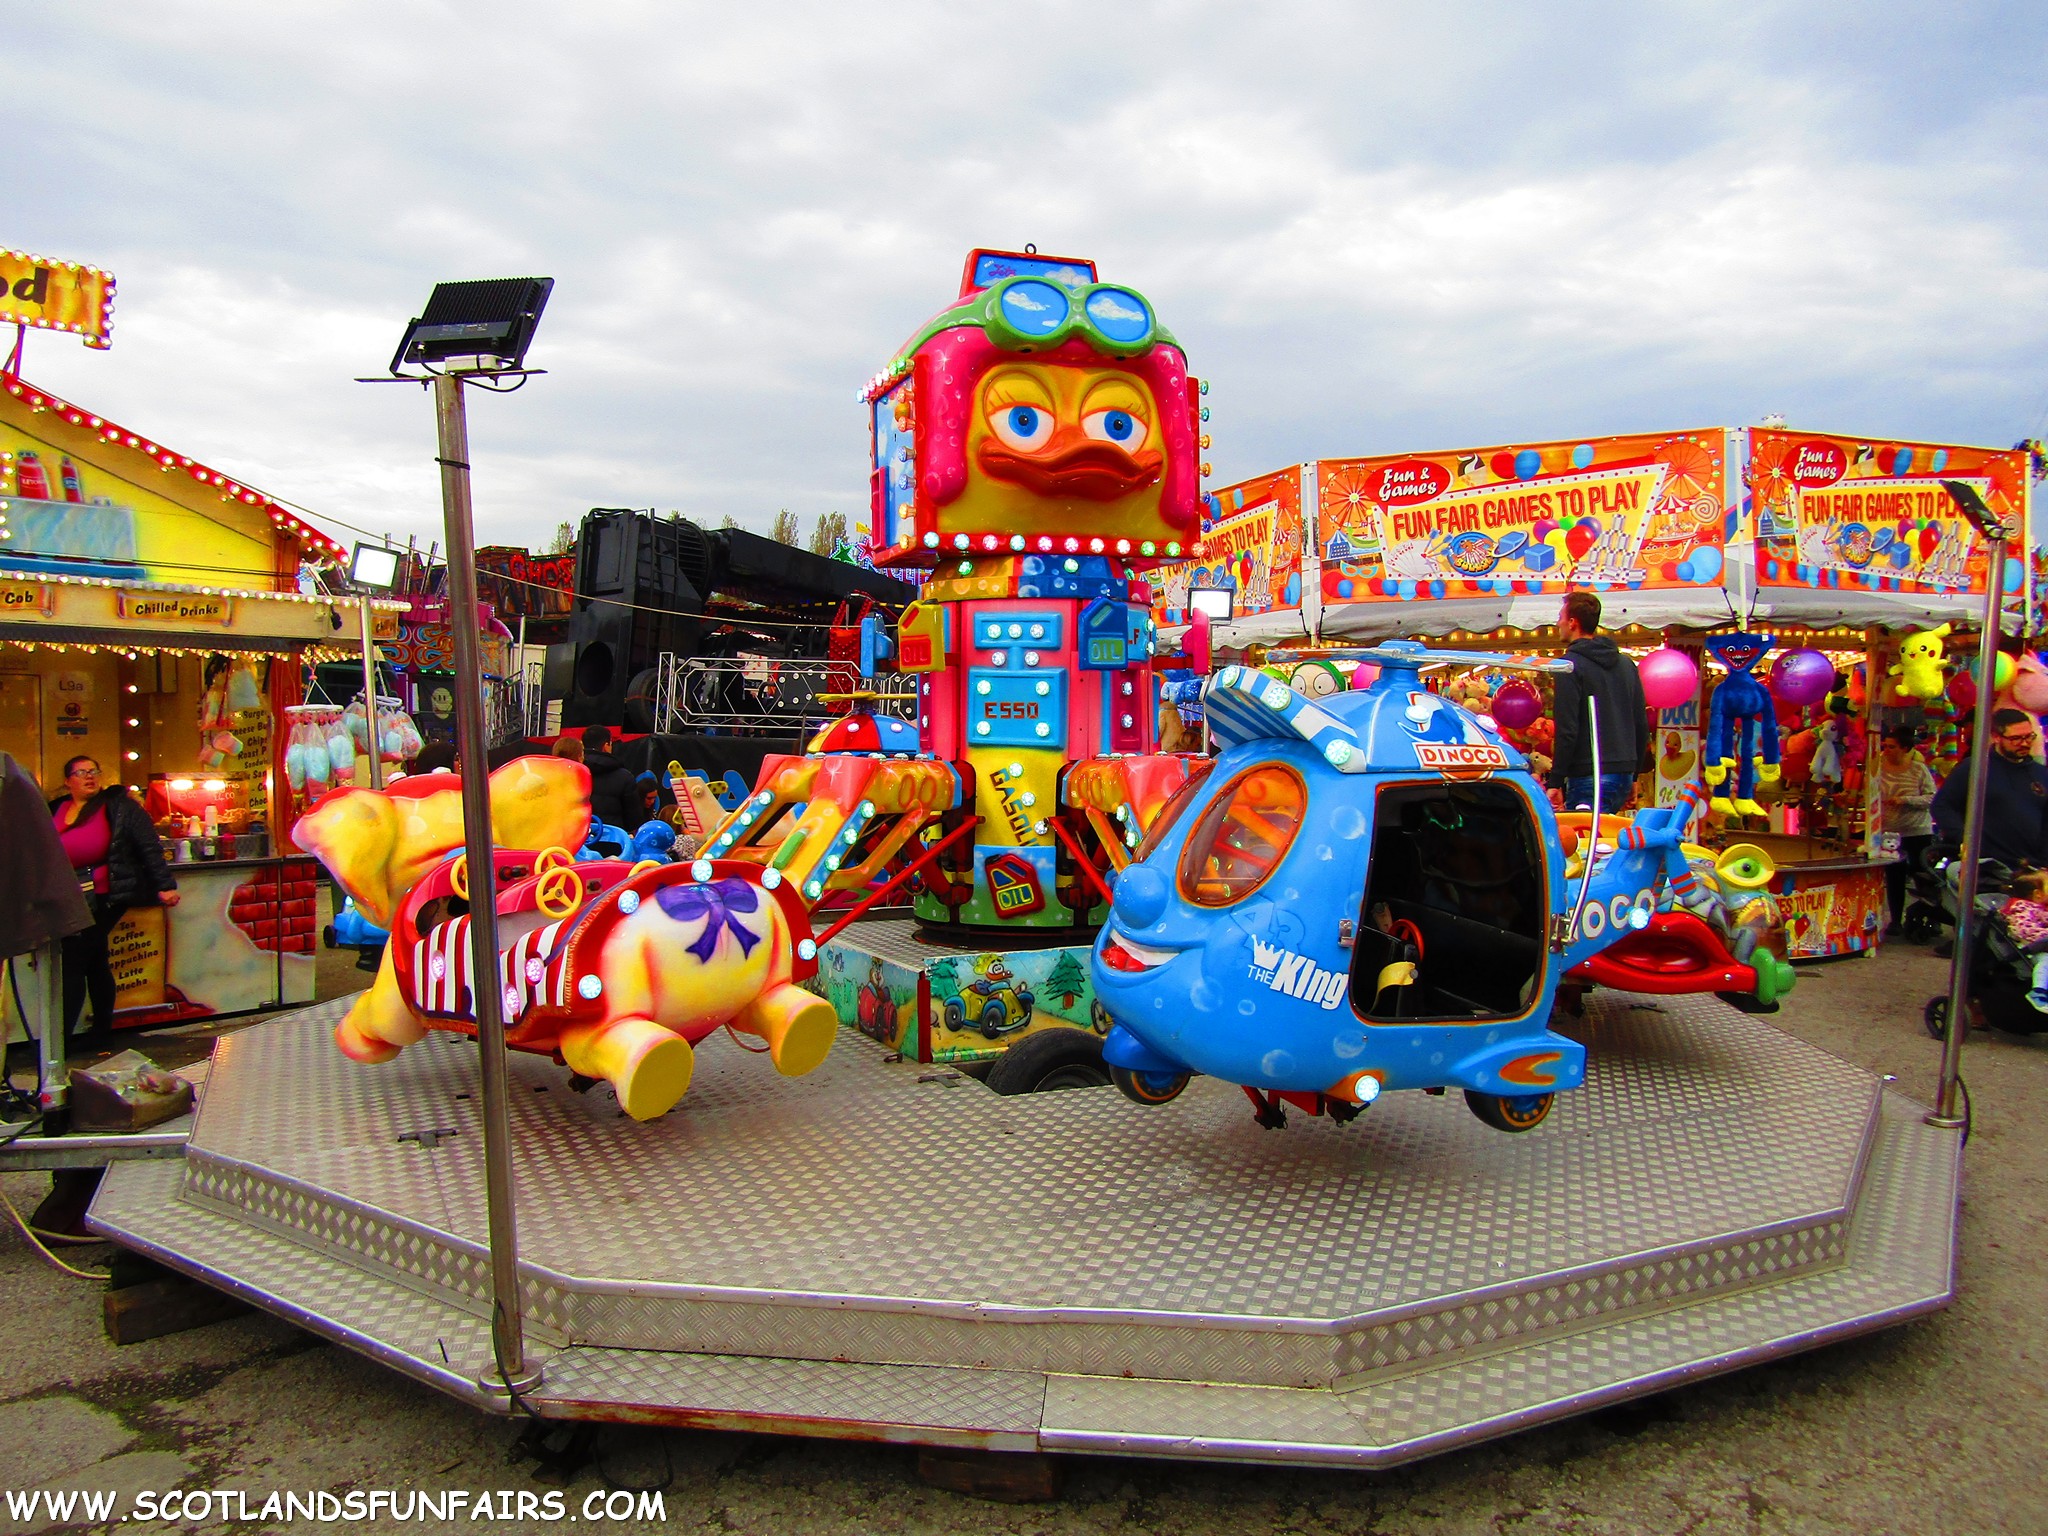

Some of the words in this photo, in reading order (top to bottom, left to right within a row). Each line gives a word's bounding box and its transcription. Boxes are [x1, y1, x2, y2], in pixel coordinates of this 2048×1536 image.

[1799, 447, 1823, 462] Fun
[1826, 450, 1834, 463] &
[1383, 468, 1415, 484] Fun
[1420, 467, 1430, 480] &
[1794, 462, 1837, 481] Games
[1378, 481, 1437, 502] Games
[1393, 509, 1432, 541] FUN
[1435, 503, 1481, 536] FAIR
[1483, 492, 1554, 528] GAMES
[1556, 488, 1585, 517] TO
[1588, 480, 1641, 515] PLAY
[1803, 494, 1830, 524] FUN
[1833, 493, 1865, 523] FAIR
[1866, 492, 1913, 522] GAMES
[1916, 491, 1935, 519] TO
[1232, 526, 1247, 551] TO
[1245, 515, 1268, 548] PLAY
[5, 590, 34, 604] Cob
[135, 601, 178, 616] Chilled
[180, 604, 219, 617] Drinks
[903, 645, 928, 663] OIL
[1091, 642, 1120, 660] OIL
[984, 702, 1039, 720] ESSO
[1662, 700, 1698, 726] DUCK
[1422, 748, 1501, 764] DINOCO
[1000, 888, 1031, 908] OIL
[1806, 891, 1827, 910] PLAY
[119, 921, 136, 931] Tea
[112, 931, 145, 945] Coffee
[127, 940, 152, 952] Choc
[118, 967, 144, 980] Latte
[1247, 964, 1275, 986] THE
[116, 977, 148, 993] Mocha
